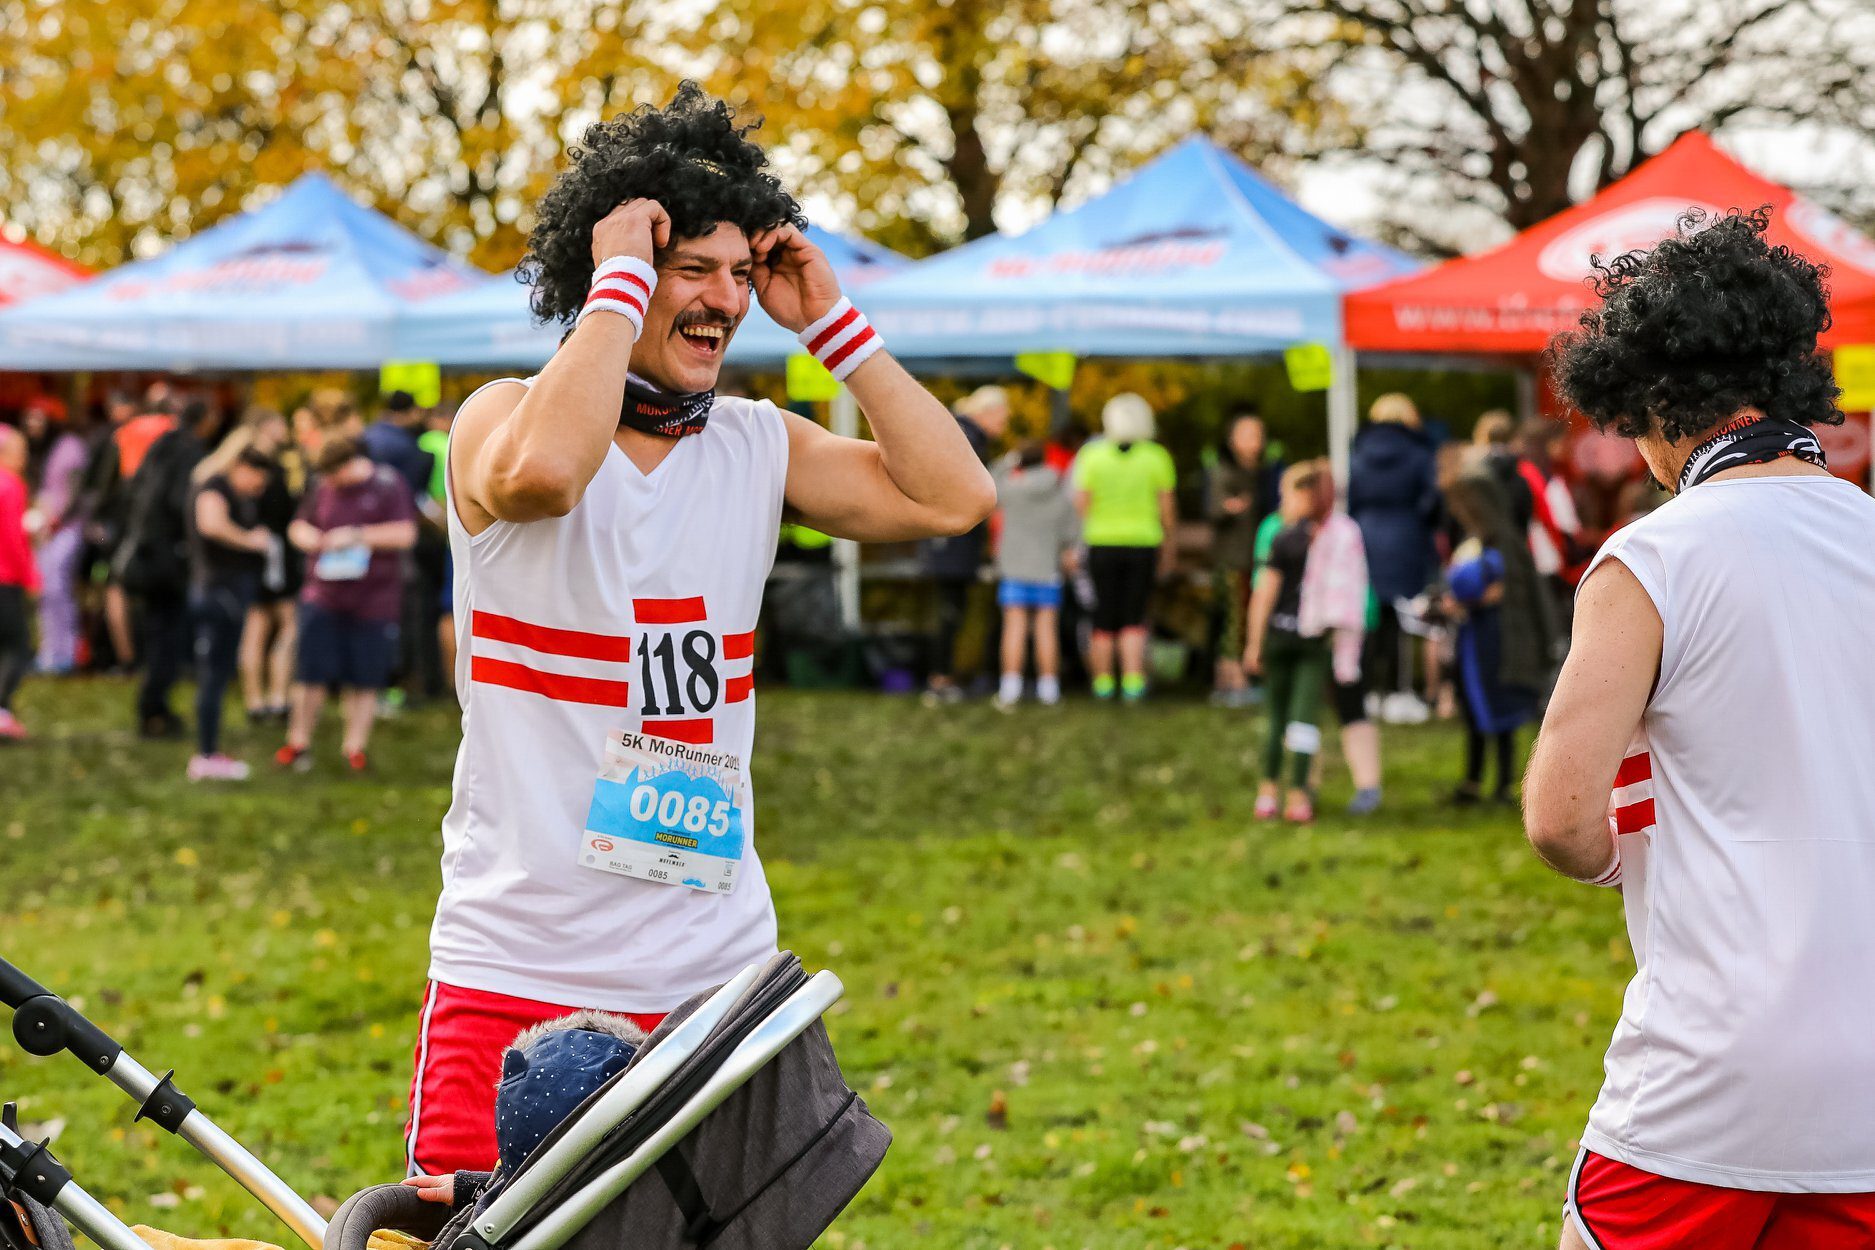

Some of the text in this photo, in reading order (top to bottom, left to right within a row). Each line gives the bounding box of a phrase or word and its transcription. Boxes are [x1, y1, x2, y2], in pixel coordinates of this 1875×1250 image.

[637, 629, 719, 716] 118
[621, 733, 643, 750] 5K
[649, 738, 723, 767] MoRunner
[629, 785, 730, 837] 0085
[655, 831, 698, 848] MORUNNER
[648, 868, 668, 880] 0085
[717, 881, 732, 891] 0085
